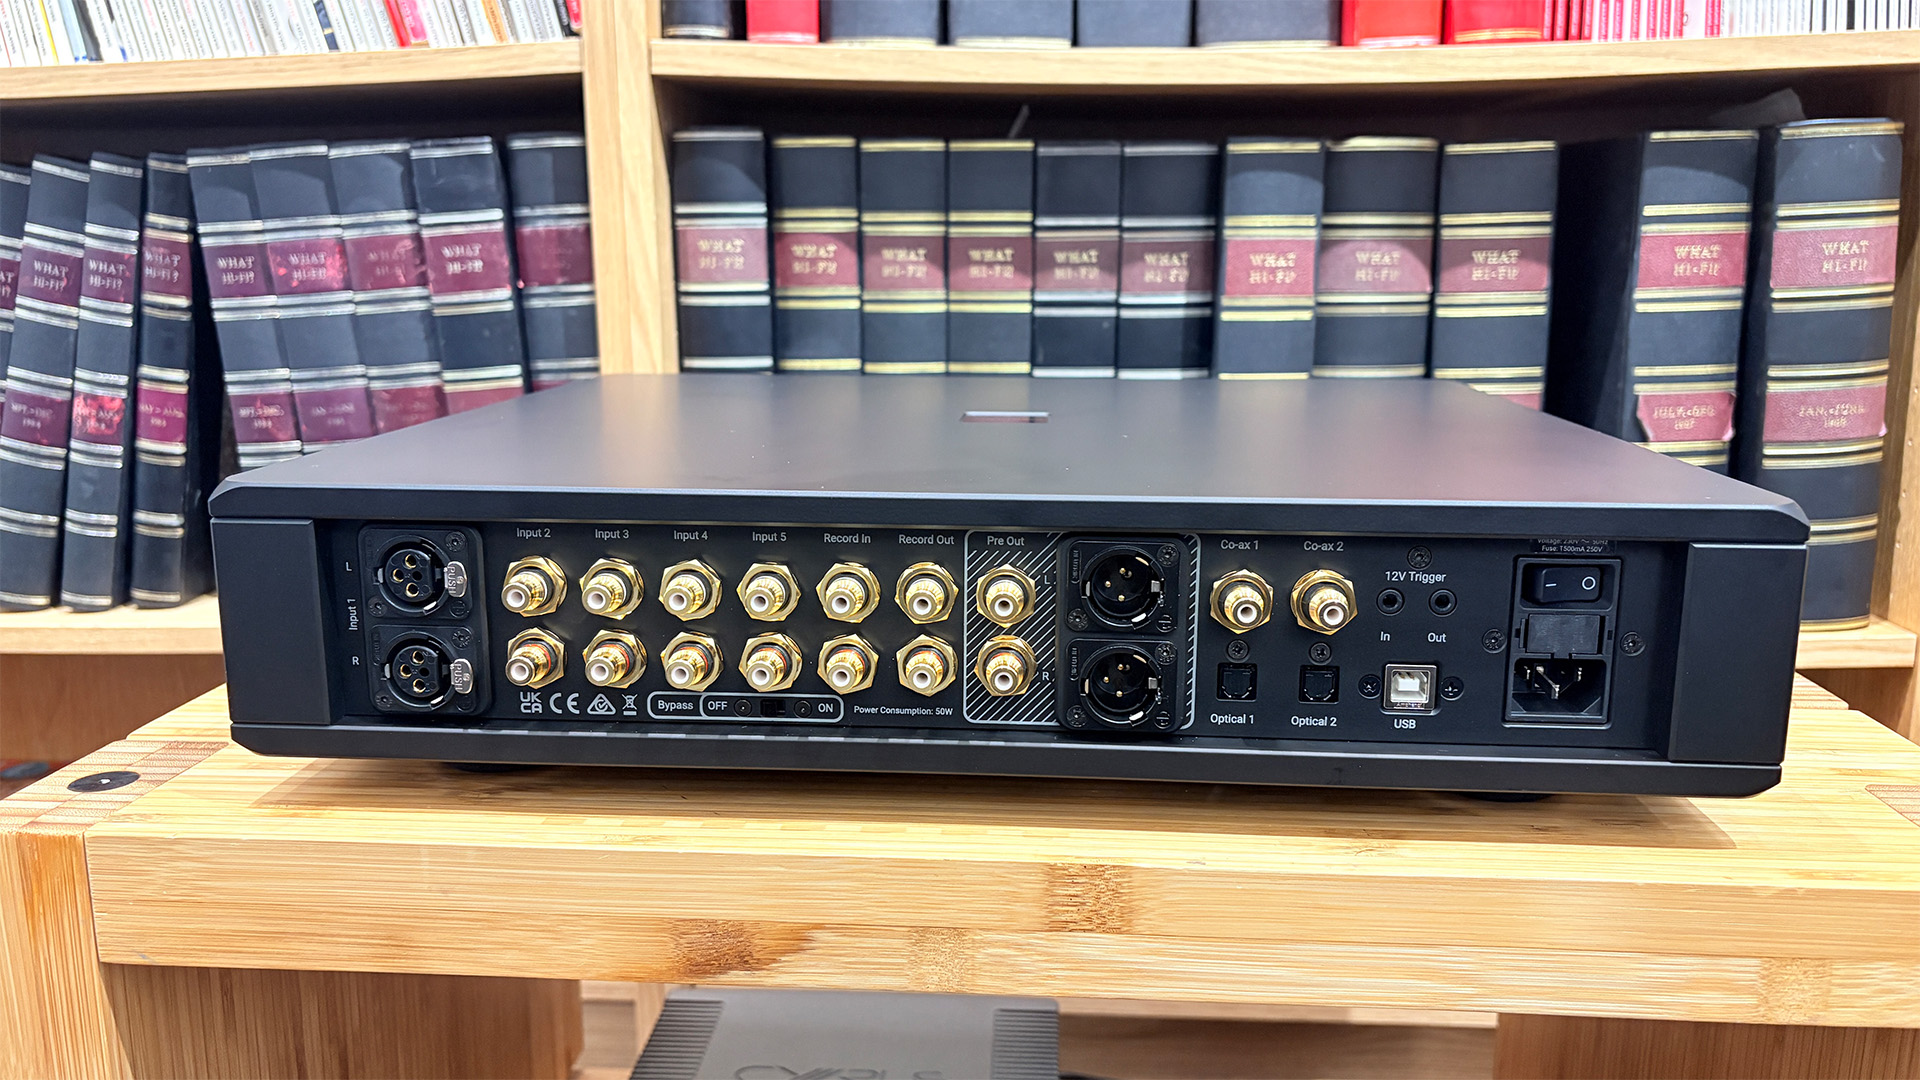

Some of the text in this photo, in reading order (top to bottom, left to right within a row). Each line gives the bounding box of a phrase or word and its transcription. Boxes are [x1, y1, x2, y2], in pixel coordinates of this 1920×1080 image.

[516, 527, 551, 539] Input 2
[595, 528, 630, 540] Input 3
[673, 530, 709, 541] Input 4
[752, 532, 787, 543] Input 5
[823, 533, 871, 544] Record In
[898, 534, 955, 545] Record Out
[987, 536, 1025, 546] Pre Out
[1220, 539, 1259, 550] Co-ax 1
[1303, 540, 1344, 551] Co-ax 2
[345, 561, 353, 572] L
[447, 566, 457, 594] PUSH
[1385, 571, 1447, 584] 12V Trigger
[348, 605, 359, 631] Input
[1380, 631, 1391, 642] In
[1427, 632, 1447, 643] Out
[352, 656, 360, 666] R
[453, 663, 463, 691] PUSH
[1042, 671, 1050, 682] R
[658, 700, 694, 711] Bypass
[707, 701, 728, 711] OFF
[818, 703, 834, 713] ON
[853, 706, 953, 716] Power Consumption: 50W
[1210, 713, 1255, 725] Optical 1
[1290, 715, 1338, 727] Optical 2
[1393, 719, 1417, 729] USB
